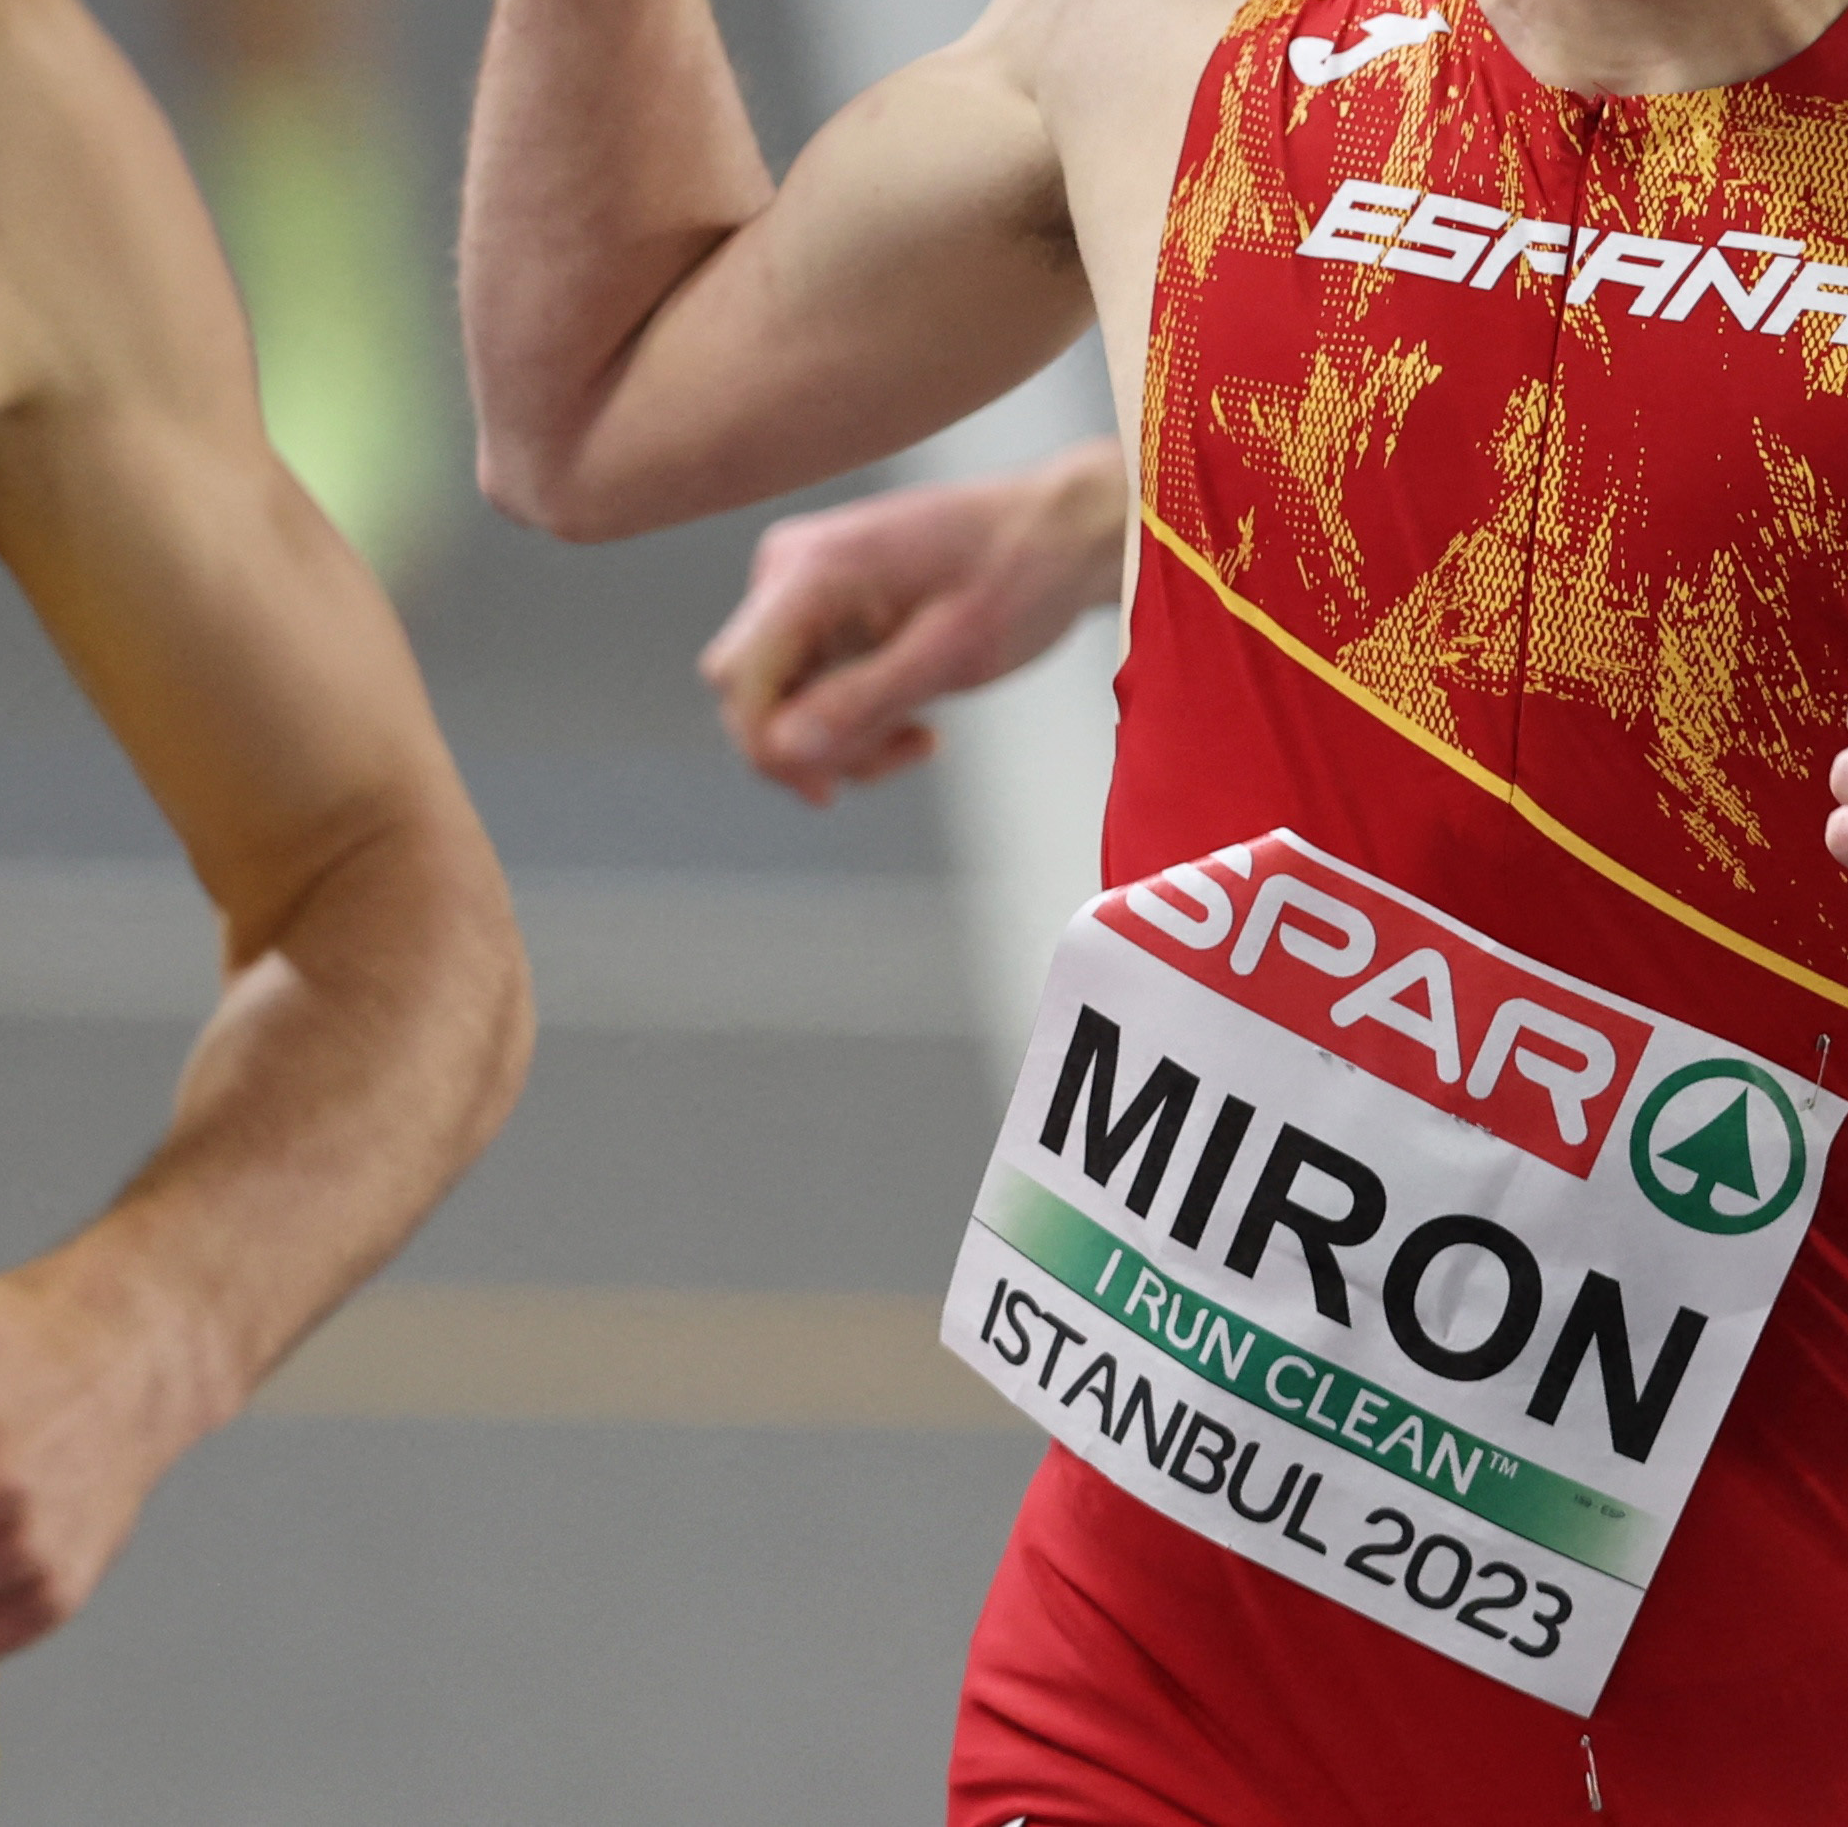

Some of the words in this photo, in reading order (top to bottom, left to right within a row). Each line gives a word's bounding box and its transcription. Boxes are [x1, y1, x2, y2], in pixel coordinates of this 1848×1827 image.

[1126, 846, 1616, 1145] SPAR
[1038, 1004, 1709, 1464] MIRON
[1094, 1249, 1123, 1295] I
[1125, 1267, 1256, 1380] RUN
[980, 1279, 1327, 1555] ISTANBUL
[1344, 1507, 1574, 1659] 2023
